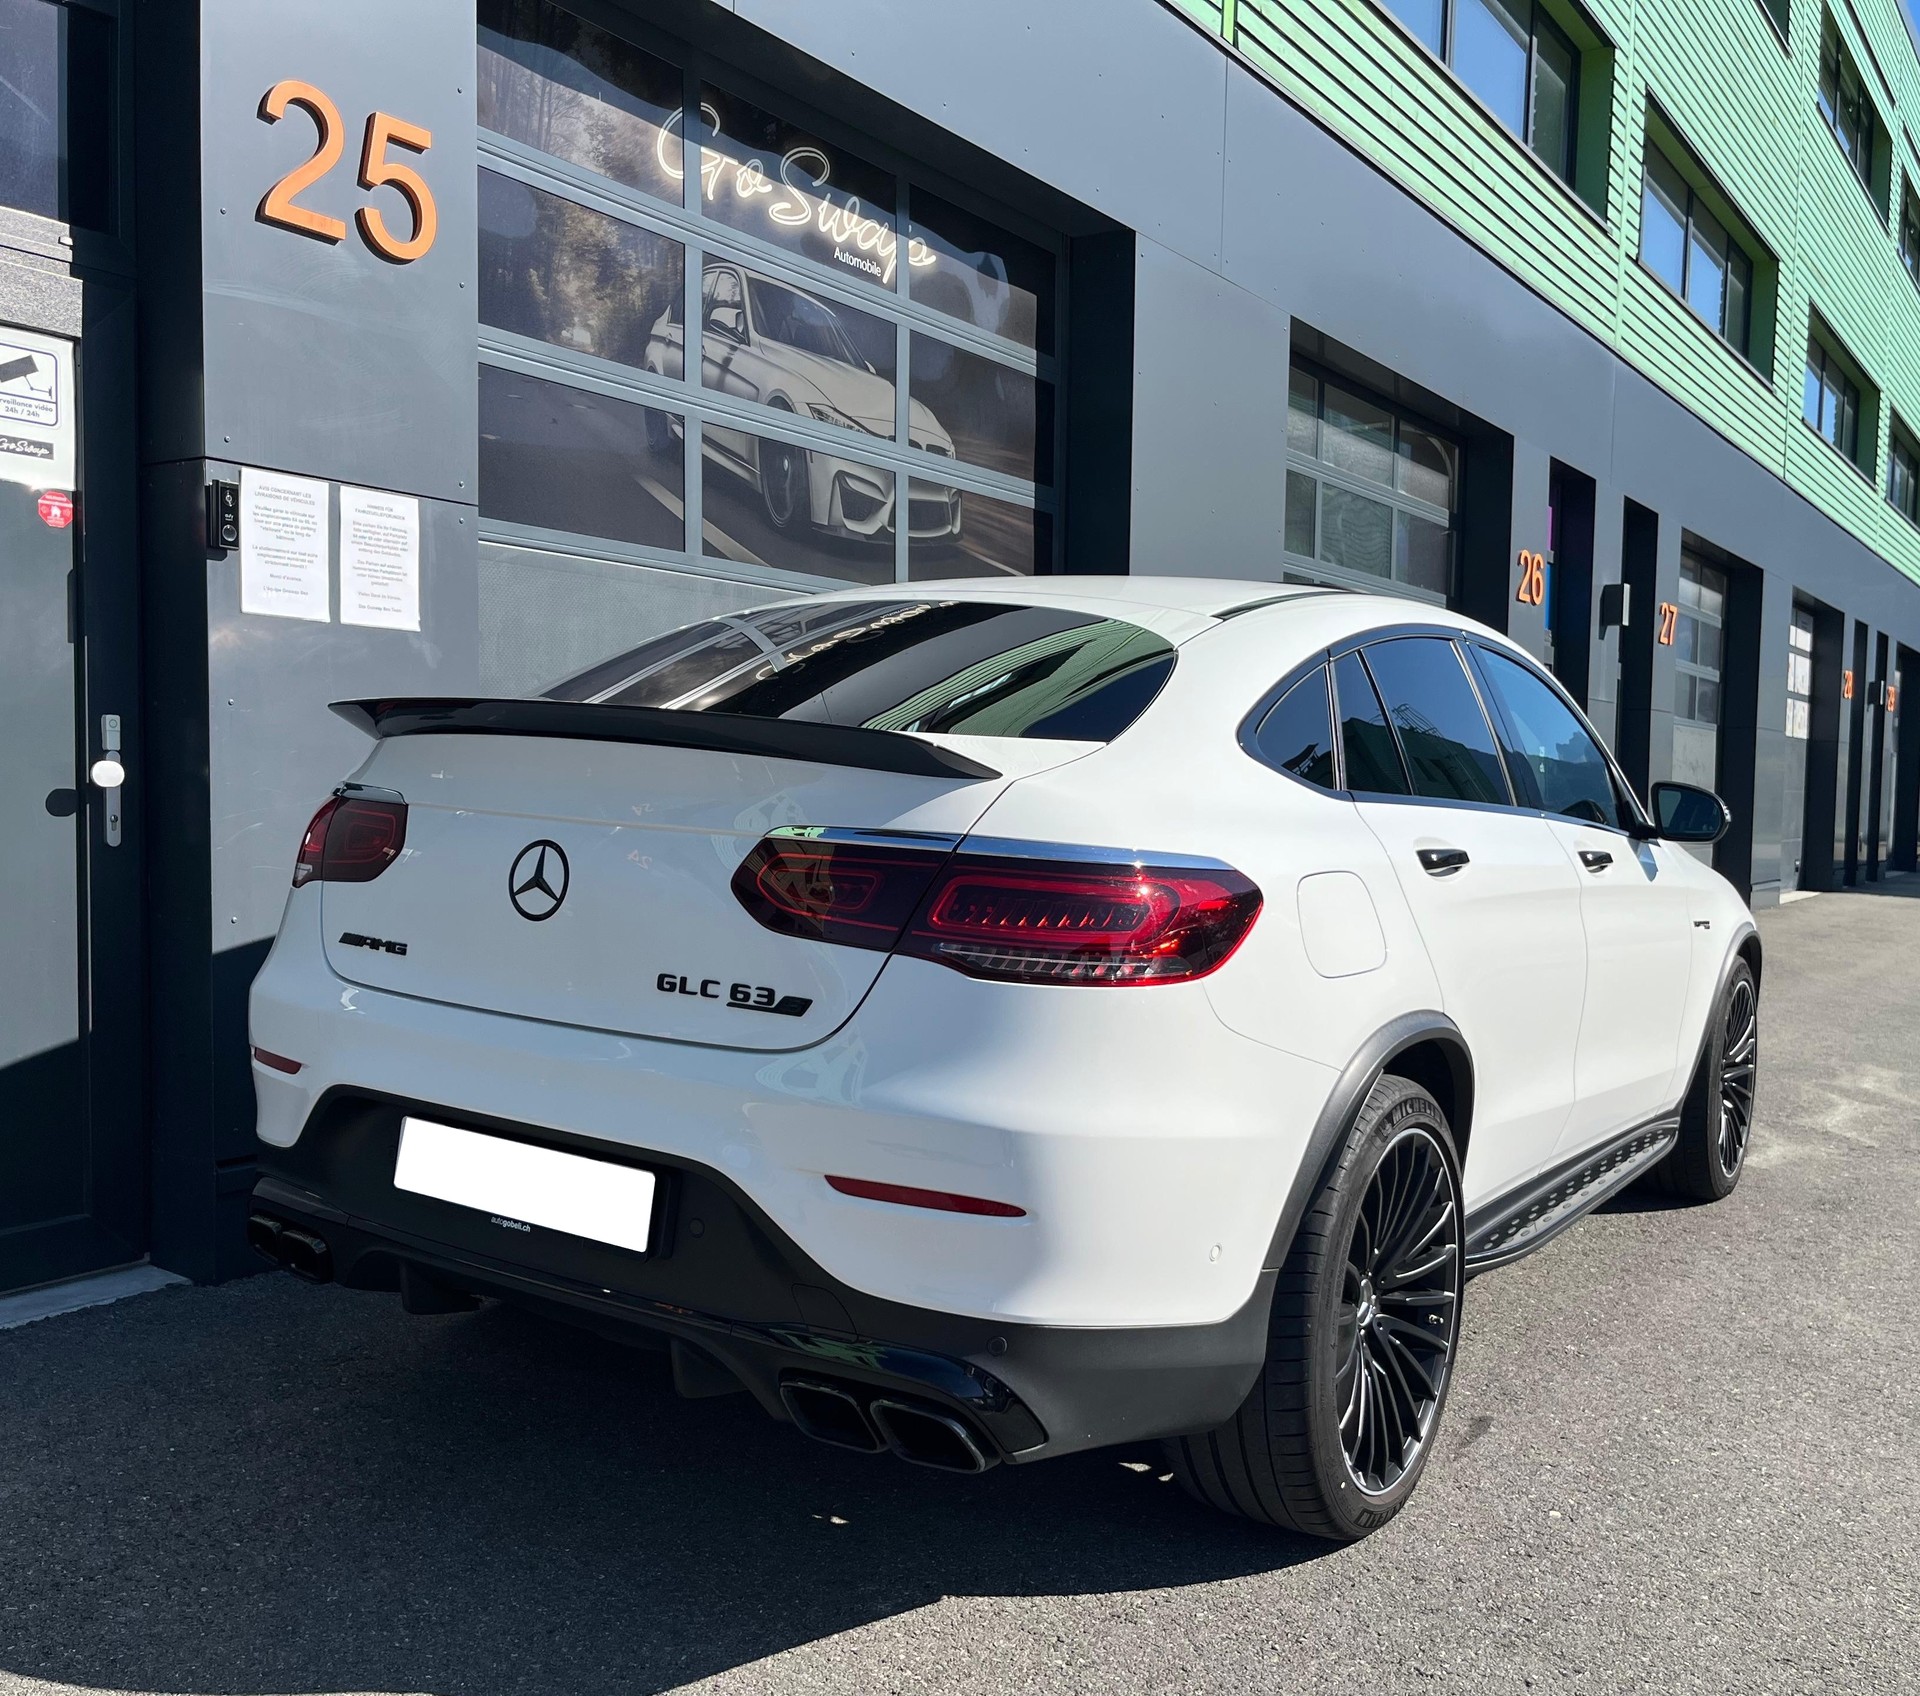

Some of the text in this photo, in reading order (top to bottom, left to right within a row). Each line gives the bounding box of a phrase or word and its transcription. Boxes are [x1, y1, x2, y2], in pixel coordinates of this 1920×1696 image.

[260, 80, 438, 262] 25
[833, 246, 882, 277] Automobile
[5, 406, 18, 414] 24h
[26, 410, 40, 418] 24h
[1517, 549, 1545, 606] 26
[1659, 601, 1678, 646] 27
[358, 935, 408, 956] AMG
[656, 973, 721, 999] GLC
[729, 983, 776, 1007] 63
